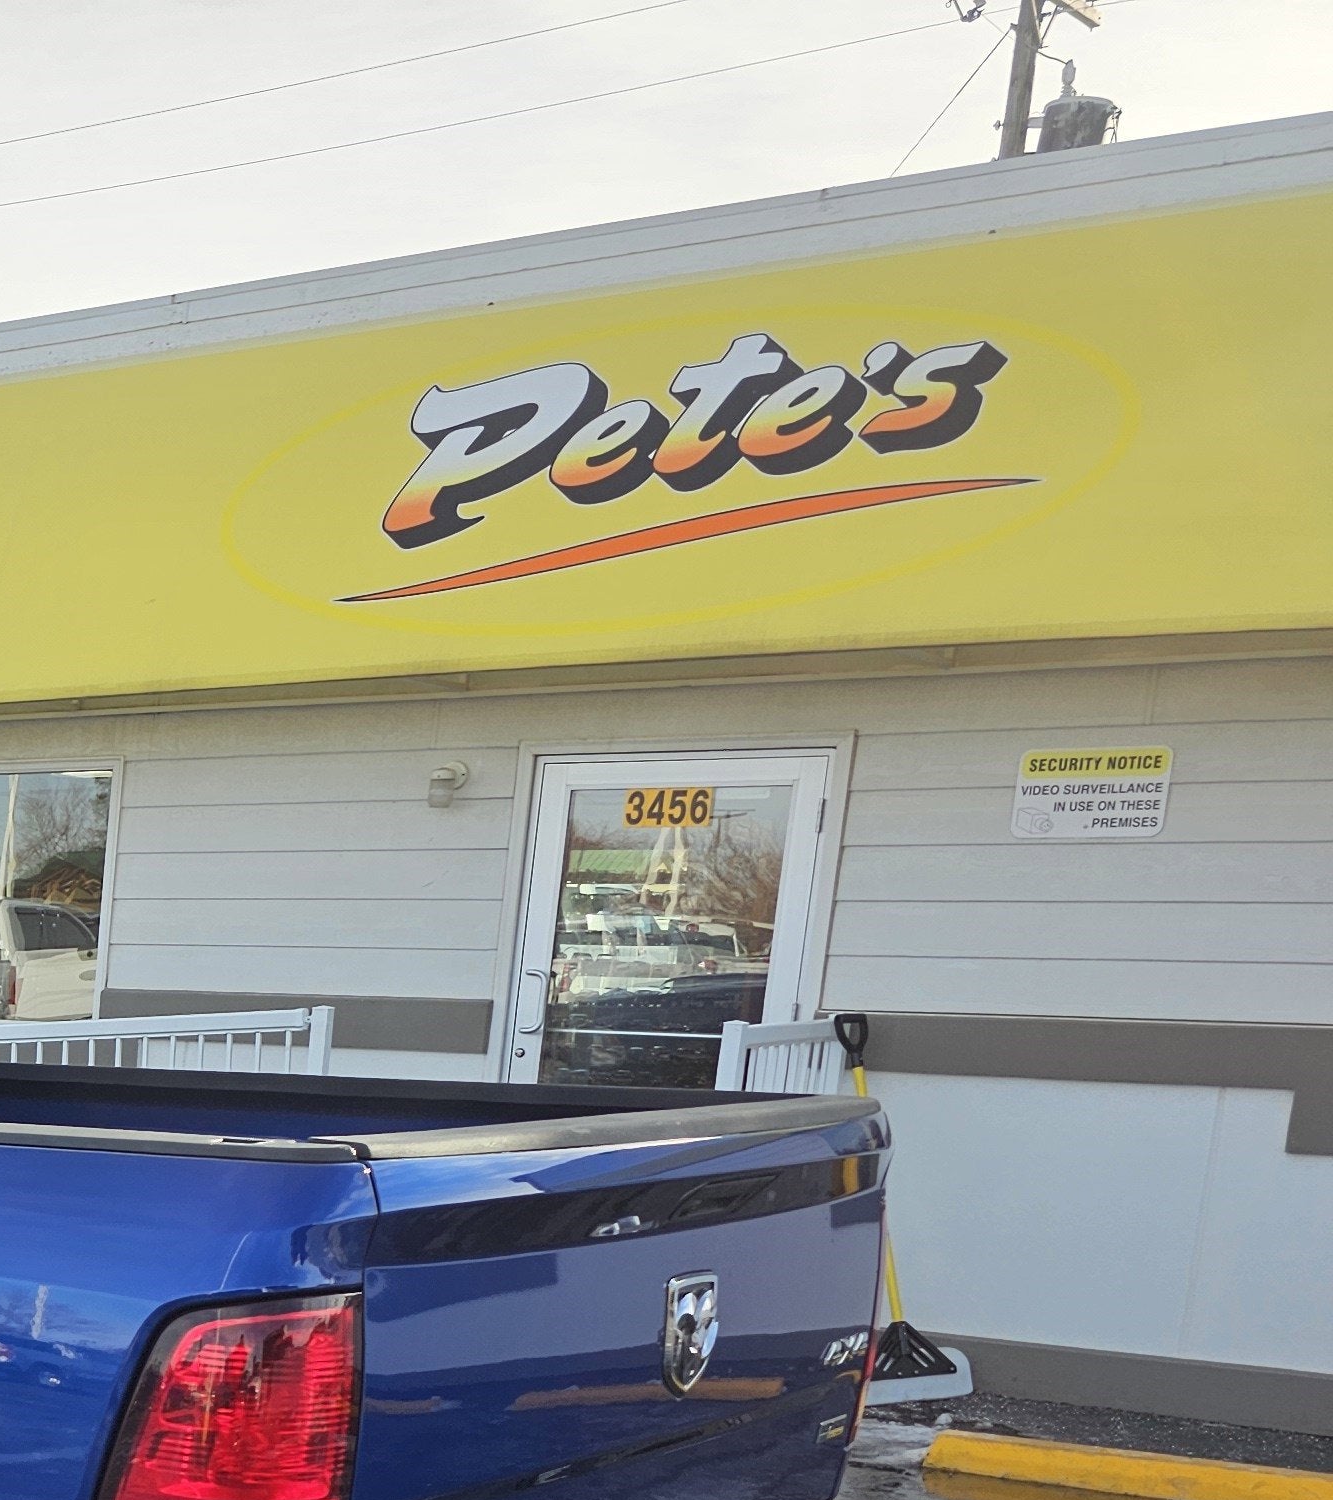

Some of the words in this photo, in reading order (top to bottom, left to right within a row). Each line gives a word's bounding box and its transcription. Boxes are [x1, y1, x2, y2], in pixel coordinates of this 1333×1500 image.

[381, 332, 1009, 549] Pete's
[1029, 756, 1102, 772] SECURITY
[1107, 755, 1163, 771] NOTICE
[1021, 785, 1060, 796] VIDEO
[1063, 782, 1163, 795] SURVEILLANCE
[625, 789, 711, 825] 3456
[1053, 802, 1066, 812] IN
[1069, 801, 1094, 812] USE
[1098, 800, 1115, 811] ON
[1119, 799, 1161, 811] THESE
[1091, 817, 1158, 828] PREMISES
